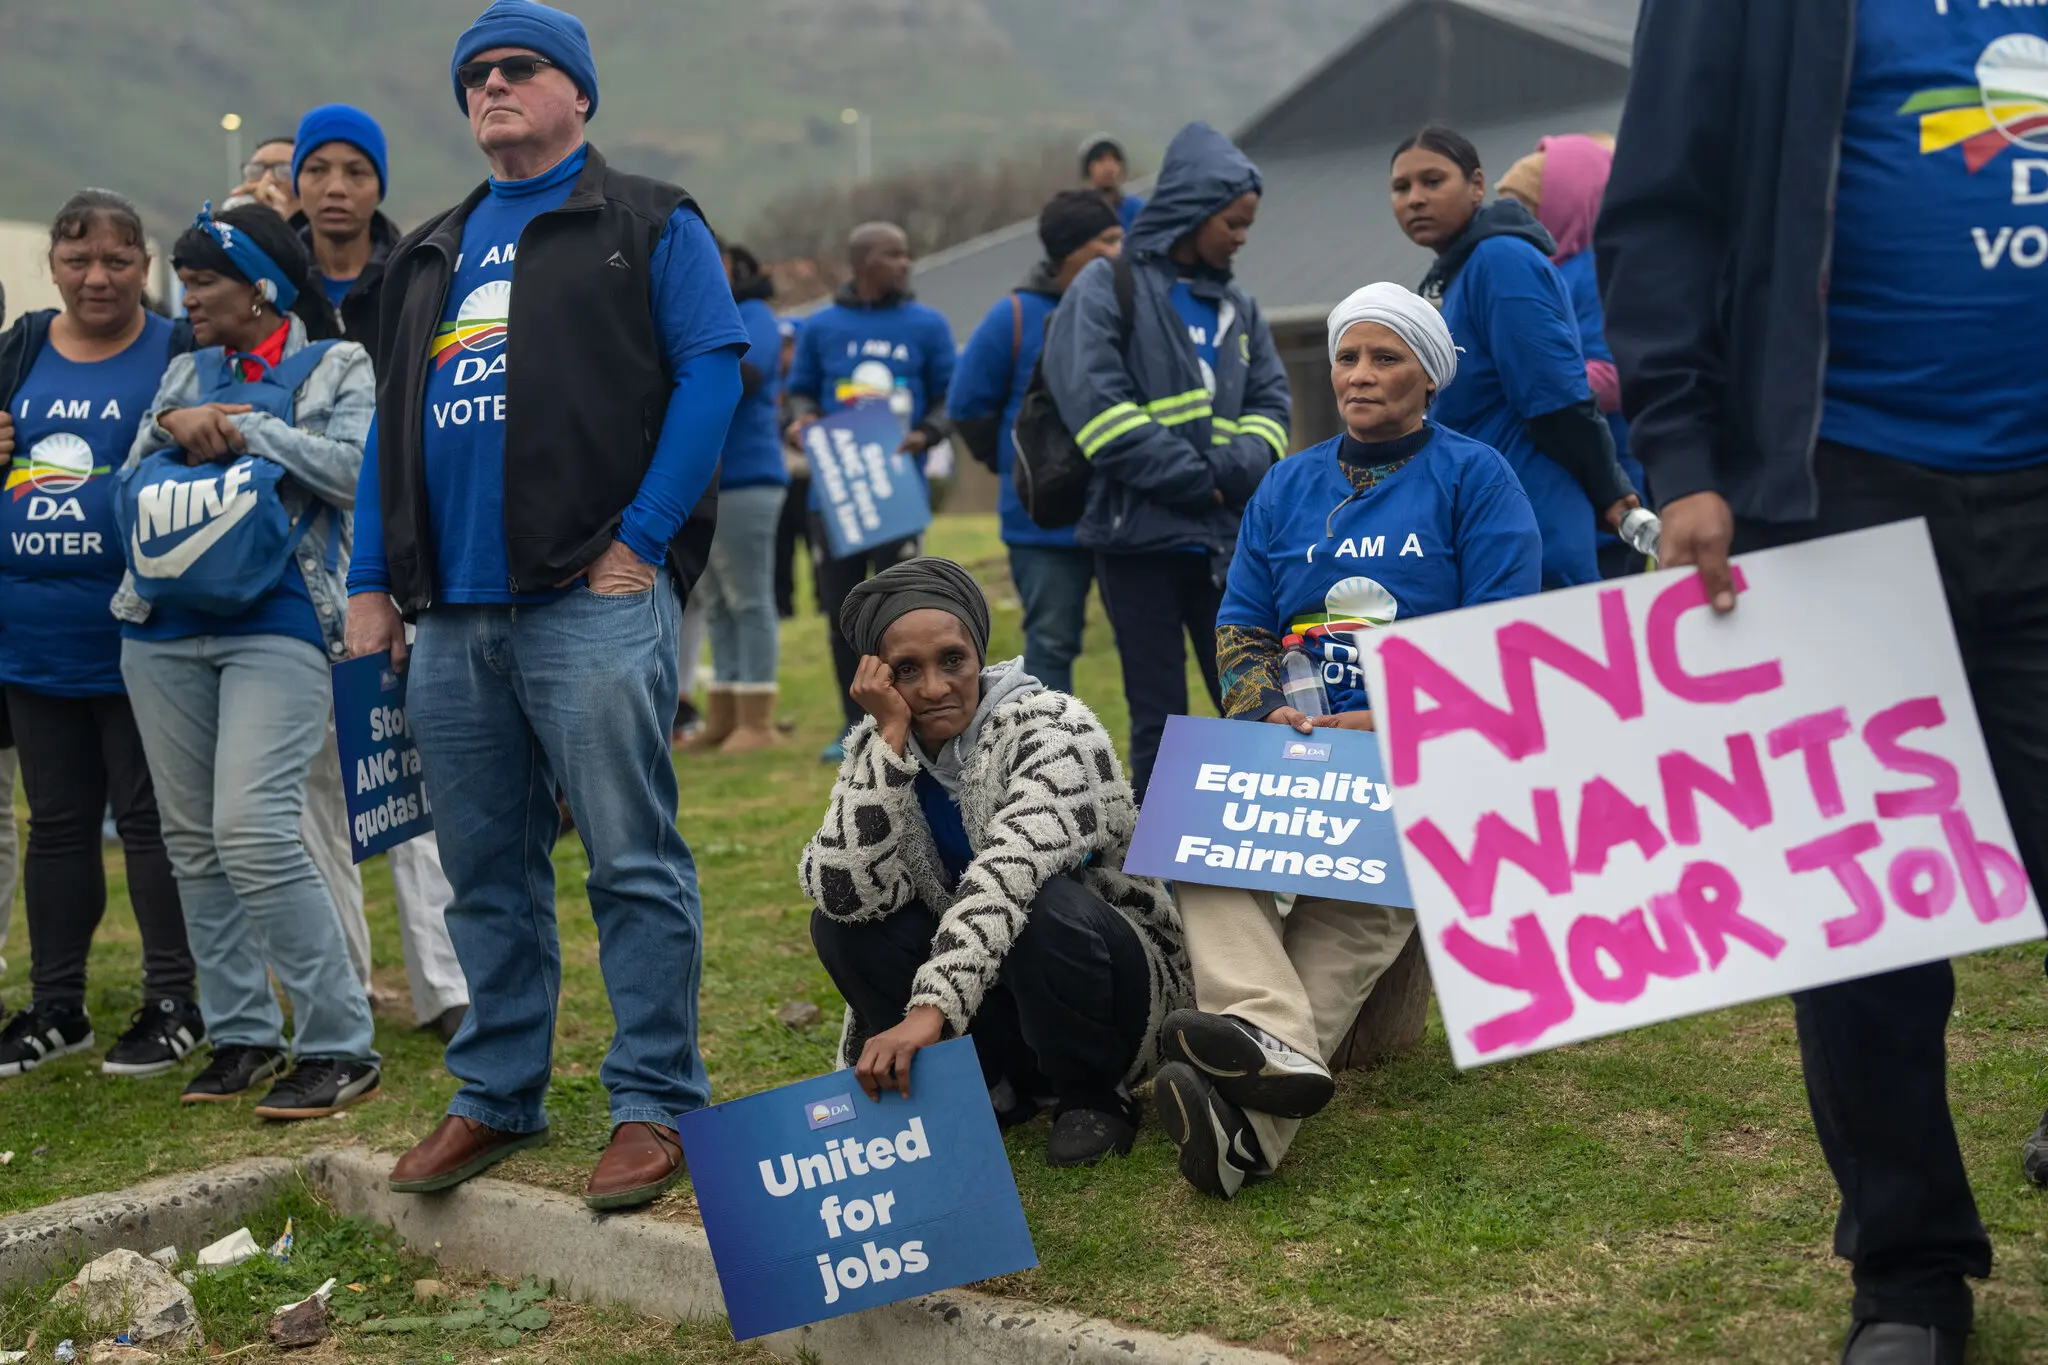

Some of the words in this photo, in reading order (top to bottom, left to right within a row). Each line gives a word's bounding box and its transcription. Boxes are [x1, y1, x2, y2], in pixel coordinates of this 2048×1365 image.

[2011, 158, 2048, 206] D
[860, 339, 892, 358] AM
[20, 398, 30, 419] I
[46, 398, 91, 419] AM
[99, 398, 122, 420] A
[433, 395, 506, 429] VOTE
[26, 496, 87, 522] DA
[138, 459, 254, 544] NIKE
[11, 531, 104, 556] VOTER
[1334, 535, 1386, 558] AM
[1399, 532, 1424, 557] A
[1324, 642, 1359, 663] D
[1376, 565, 1785, 788] ANC
[356, 748, 398, 795] ANC
[401, 746, 422, 777] ra
[1307, 748, 1326, 757] DA
[1195, 763, 1394, 812] Equality
[1405, 696, 1961, 918] WANTS
[354, 792, 419, 848] quotas
[1222, 802, 1361, 846] Unity
[1175, 835, 1388, 885] Fairness
[831, 1103, 849, 1117] DA
[758, 1116, 931, 1197] United
[819, 1190, 896, 1239] for
[816, 1240, 929, 1304] jobs
